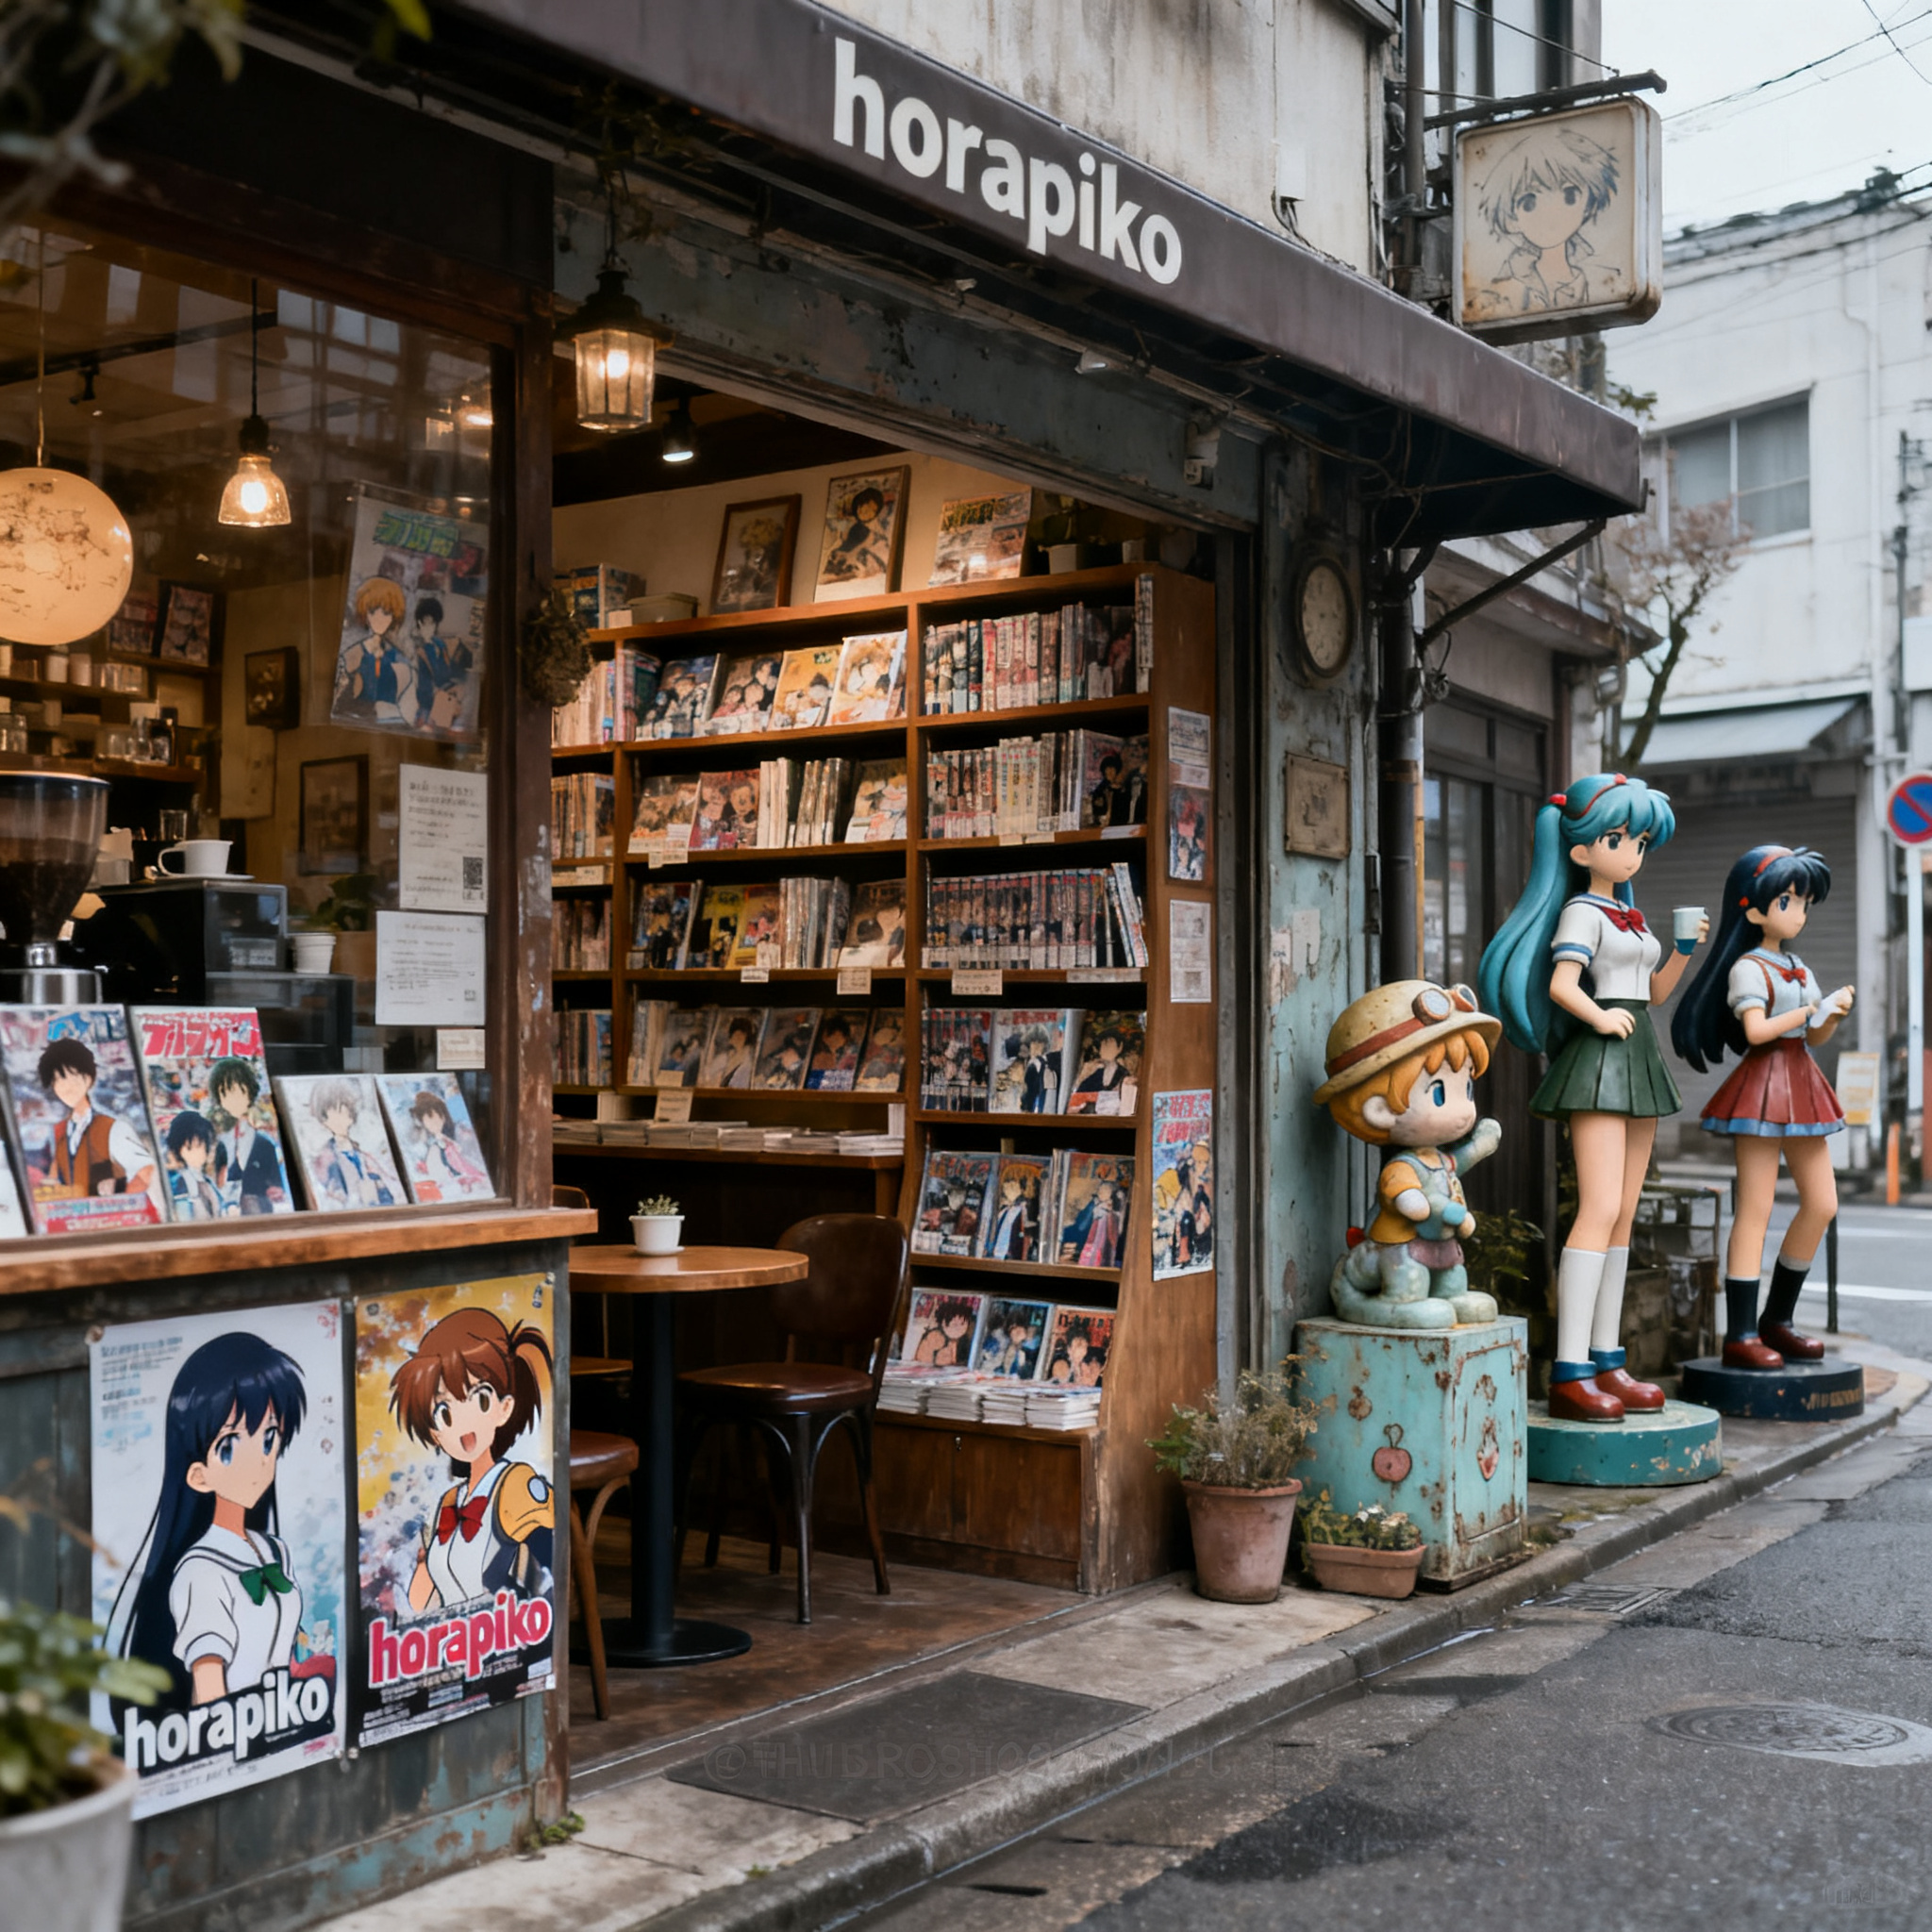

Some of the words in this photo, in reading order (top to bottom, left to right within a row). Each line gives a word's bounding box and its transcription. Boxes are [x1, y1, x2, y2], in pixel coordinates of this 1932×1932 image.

[833, 37, 1182, 285] horapiko
[369, 1591, 552, 1688] horapiko
[124, 1669, 329, 1769] horapiko
